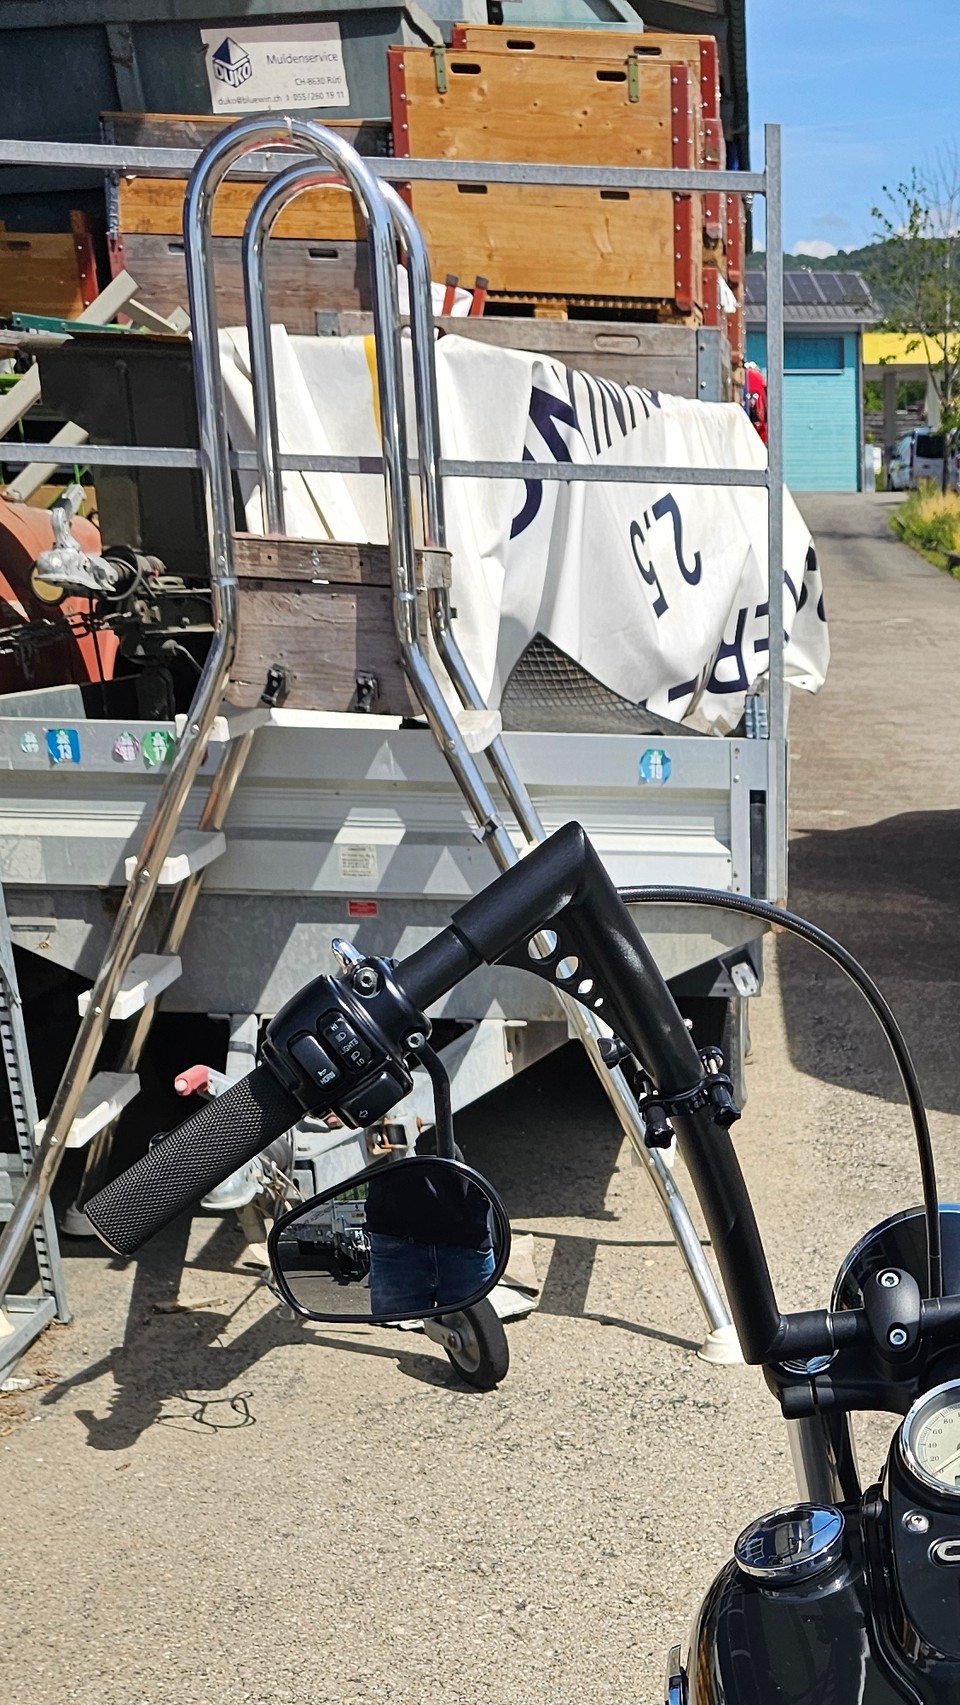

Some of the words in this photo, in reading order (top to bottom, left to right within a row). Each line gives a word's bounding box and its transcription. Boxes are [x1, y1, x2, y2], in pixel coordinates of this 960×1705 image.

[266, 52, 339, 65] Muldenservice
[213, 61, 252, 88] DUKO
[330, 1023, 339, 1032] HI
[356, 1058, 366, 1067] LO
[320, 1071, 336, 1085] HORN
